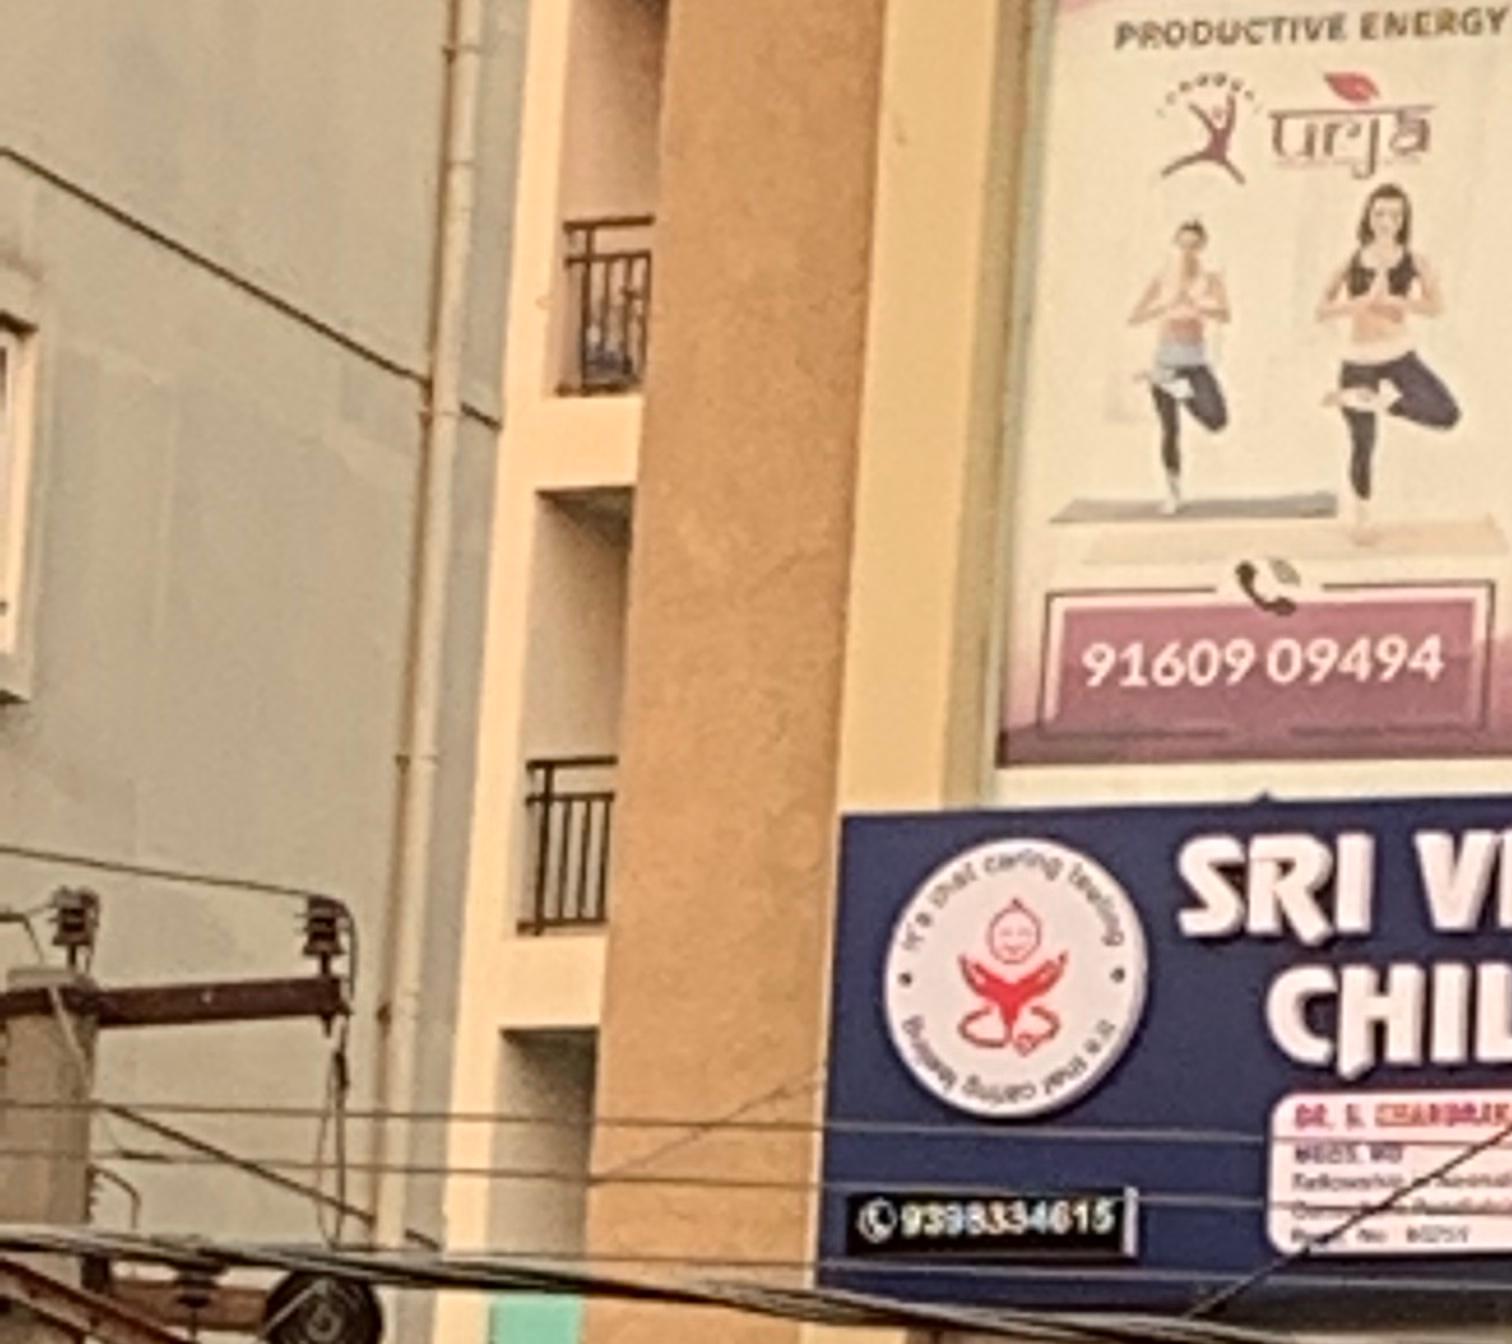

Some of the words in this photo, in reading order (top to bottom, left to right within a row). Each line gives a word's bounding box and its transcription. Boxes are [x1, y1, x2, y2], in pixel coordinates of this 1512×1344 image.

[1114, 17, 1346, 50] PRODUCTIVE
[1361, 12, 1509, 42] ENERGY
[1082, 637, 1256, 688] 91609
[1268, 634, 1445, 684] 09494
[1177, 831, 1374, 945] SRI
